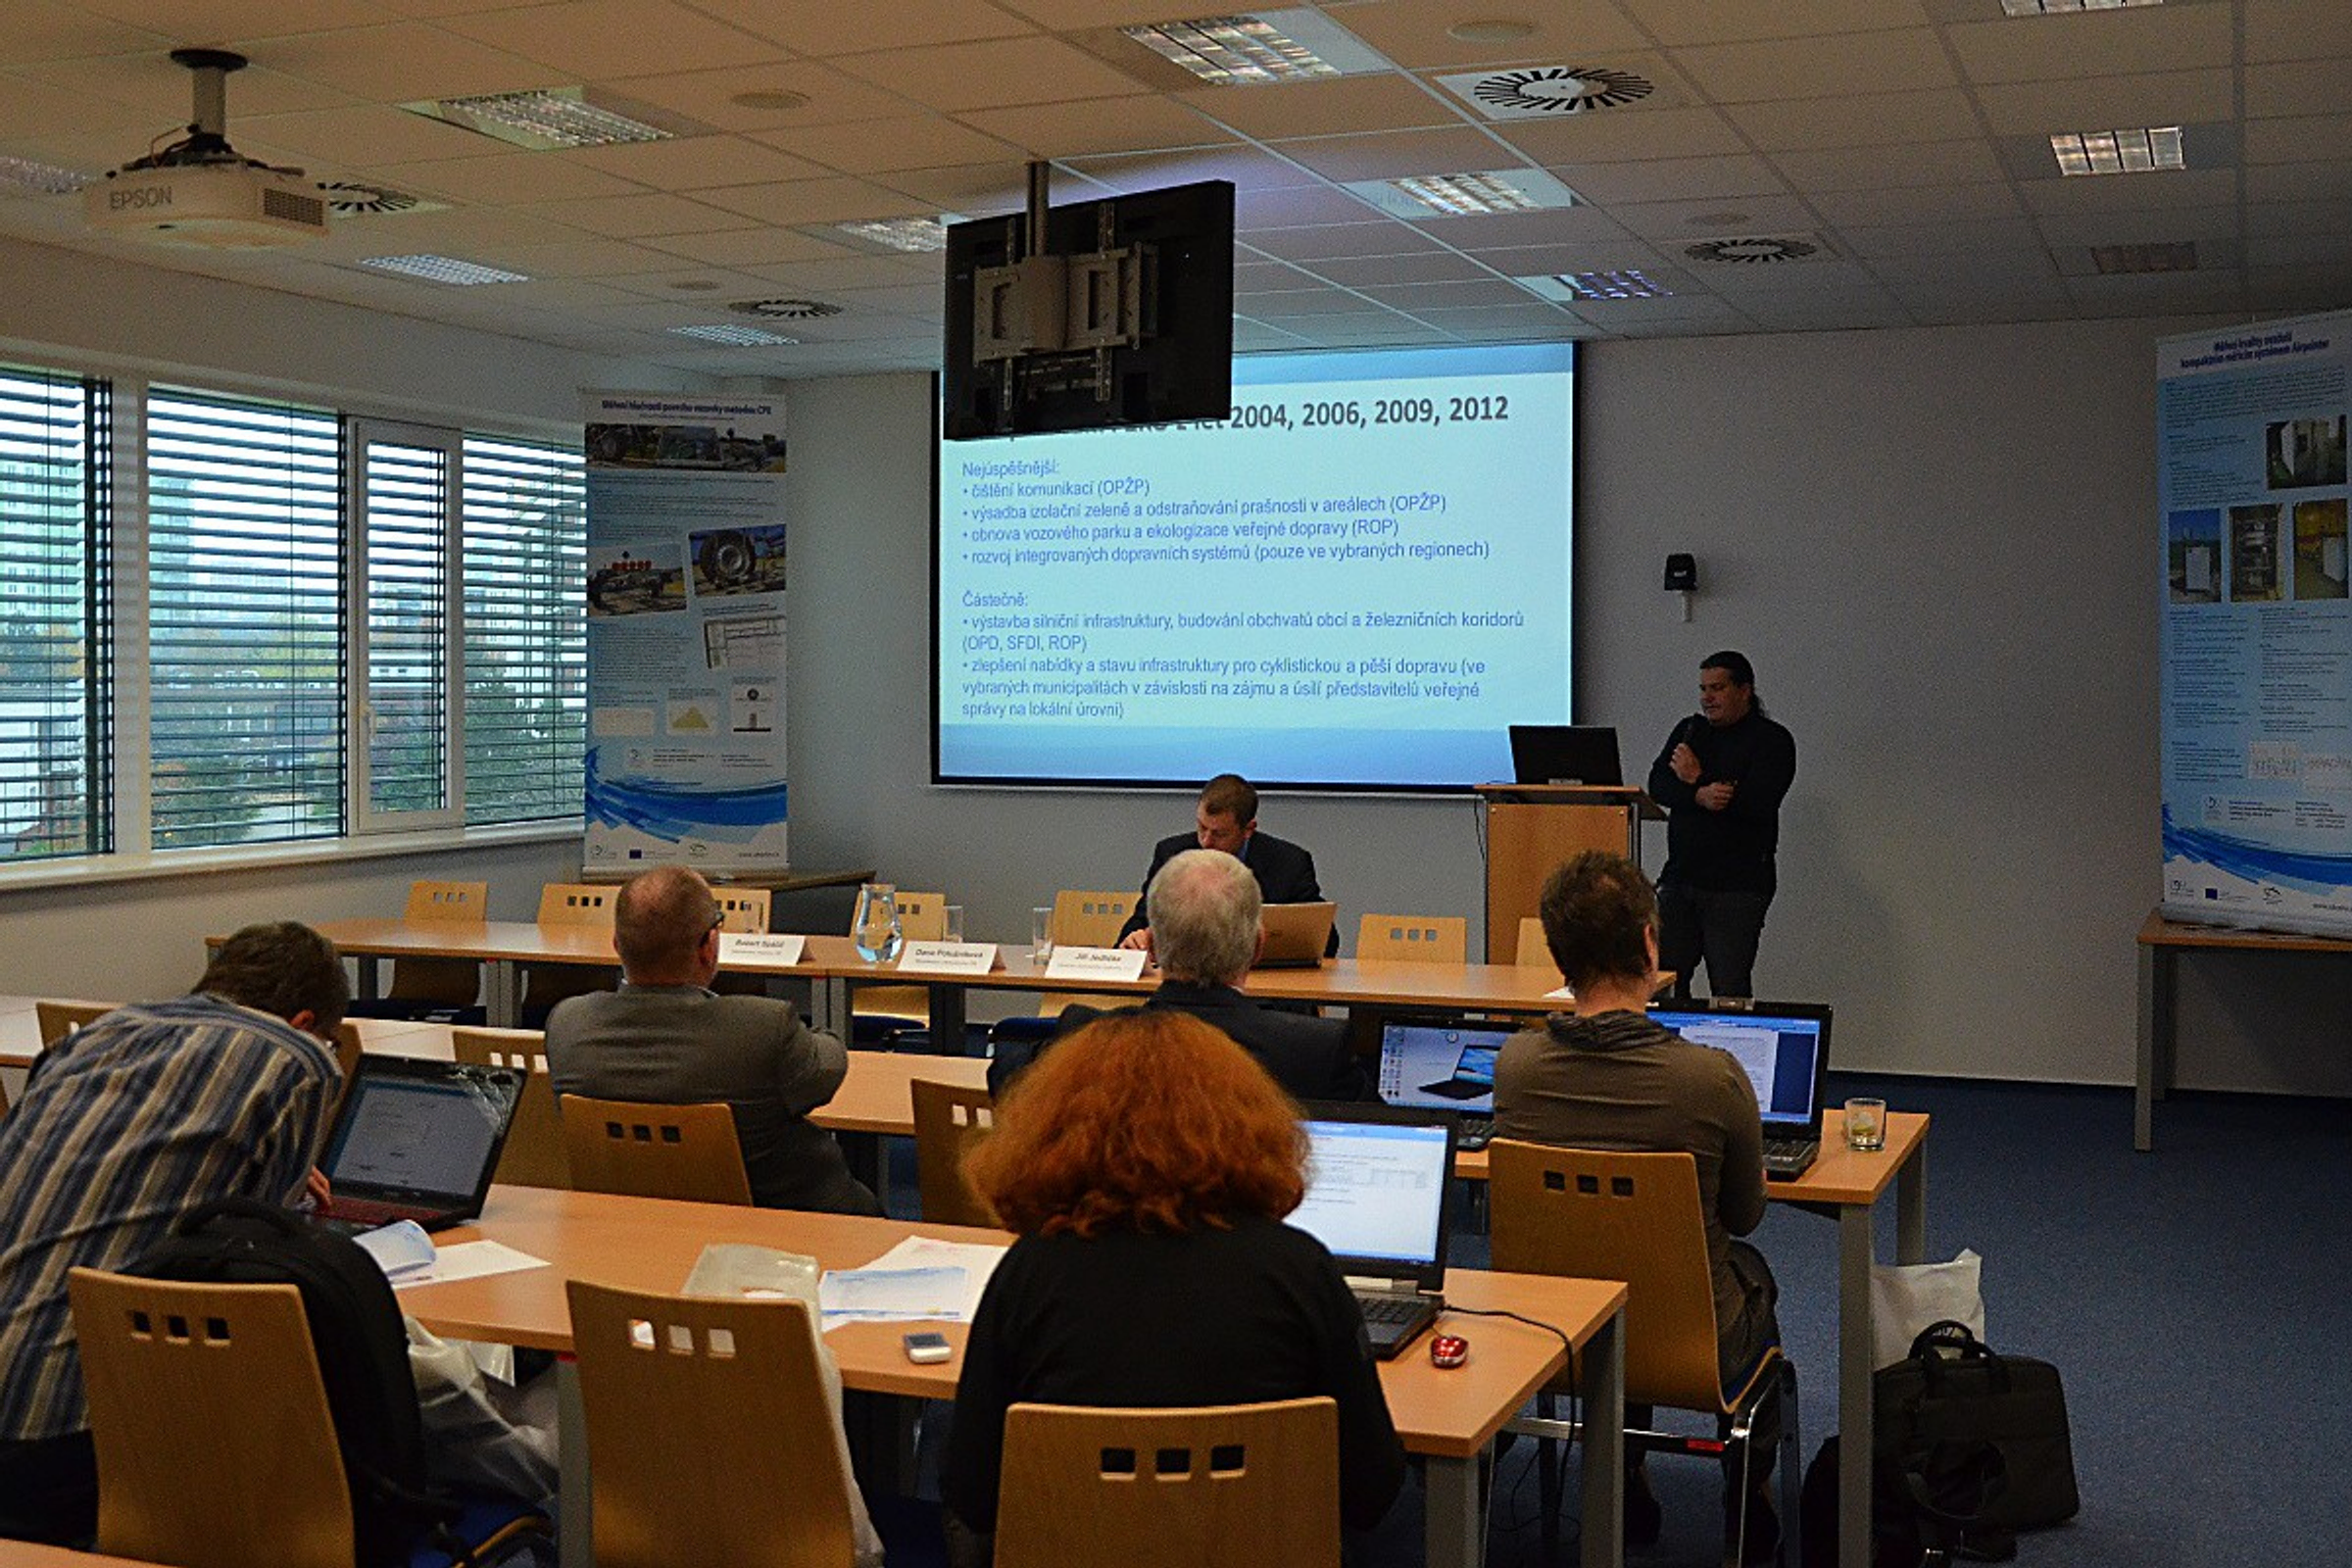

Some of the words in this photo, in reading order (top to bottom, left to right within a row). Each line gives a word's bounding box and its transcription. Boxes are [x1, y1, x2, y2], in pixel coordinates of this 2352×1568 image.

[108, 186, 172, 211] EPSON
[1231, 404, 1294, 431] 2004,
[1302, 402, 1366, 428] 2006,
[1375, 398, 1440, 426] 2009,
[1449, 395, 1508, 420] 2012
[962, 459, 1059, 477] Nejúspěšnější:
[972, 482, 1013, 498] čištění
[1017, 480, 1093, 497] komunikací
[1098, 477, 1151, 497] (OPŽP)
[972, 505, 1026, 520] výsadba
[1031, 503, 1081, 518] izolační
[1085, 502, 1129, 517] zeleně
[1134, 505, 1143, 516] a
[1147, 500, 1238, 516] odstraňování
[1242, 498, 1307, 514] prašnosti
[1310, 502, 1318, 513] v
[1322, 495, 1386, 513] areálech
[1390, 492, 1446, 514] (OPŽP)
[972, 526, 1020, 541] obnova
[1023, 524, 1089, 541] vozového
[1092, 523, 1131, 541] parku
[1134, 527, 1143, 538] a
[1147, 522, 1229, 542] ekologizace
[1234, 521, 1286, 538] veřejné
[1290, 519, 1348, 538] dopravy
[1351, 518, 1399, 536] (ROP)
[972, 551, 1011, 565] rozvoj
[1014, 547, 1108, 565] integrovaných
[1111, 546, 1189, 564] dopravních
[1192, 545, 1250, 562] systémů
[1254, 543, 1304, 562] (pouze
[1308, 546, 1326, 558] ve
[1329, 542, 1404, 561] vybraných
[1409, 540, 1490, 560] regionech)
[962, 590, 1028, 608] Částečně:
[972, 614, 1030, 631] výstavba
[1033, 613, 1078, 628] silniční
[1083, 613, 1173, 631] infrastruktury,
[1178, 612, 1244, 628] budování
[1247, 612, 1312, 629] obchvatů
[1316, 612, 1348, 627] obcí
[1351, 615, 1360, 626] a
[1365, 612, 1457, 628] železničních
[1461, 611, 1525, 627] koridorů
[962, 635, 1003, 653] (OPD,
[1006, 635, 1044, 652] SFDI,
[1048, 635, 1087, 653] ROP)
[971, 659, 1026, 674] zlepšení
[1030, 658, 1082, 675] nabídky
[1086, 662, 1095, 672] a
[1099, 659, 1136, 672] stavu
[1139, 657, 1229, 675] infrastruktury
[1233, 662, 1256, 674] pro
[1260, 658, 1341, 675] cyklistickou
[1347, 662, 1355, 673] a
[1360, 659, 1392, 677] pěší
[1396, 659, 1457, 676] dopravu
[1461, 658, 1485, 676] (ve
[962, 679, 1029, 697] vybraných
[1033, 679, 1127, 697] municipalitách
[1132, 684, 1140, 695] v
[1144, 679, 1206, 695] závislosti
[1211, 684, 1228, 695] na
[1233, 681, 1275, 699] zájmu
[1280, 685, 1289, 696] a
[1293, 680, 1322, 696] úsilí
[1326, 680, 1419, 700] představitelů
[1424, 681, 1480, 701] veřejné
[962, 702, 1006, 718] správy
[1009, 706, 1025, 716] na
[1029, 701, 1072, 716] lokální
